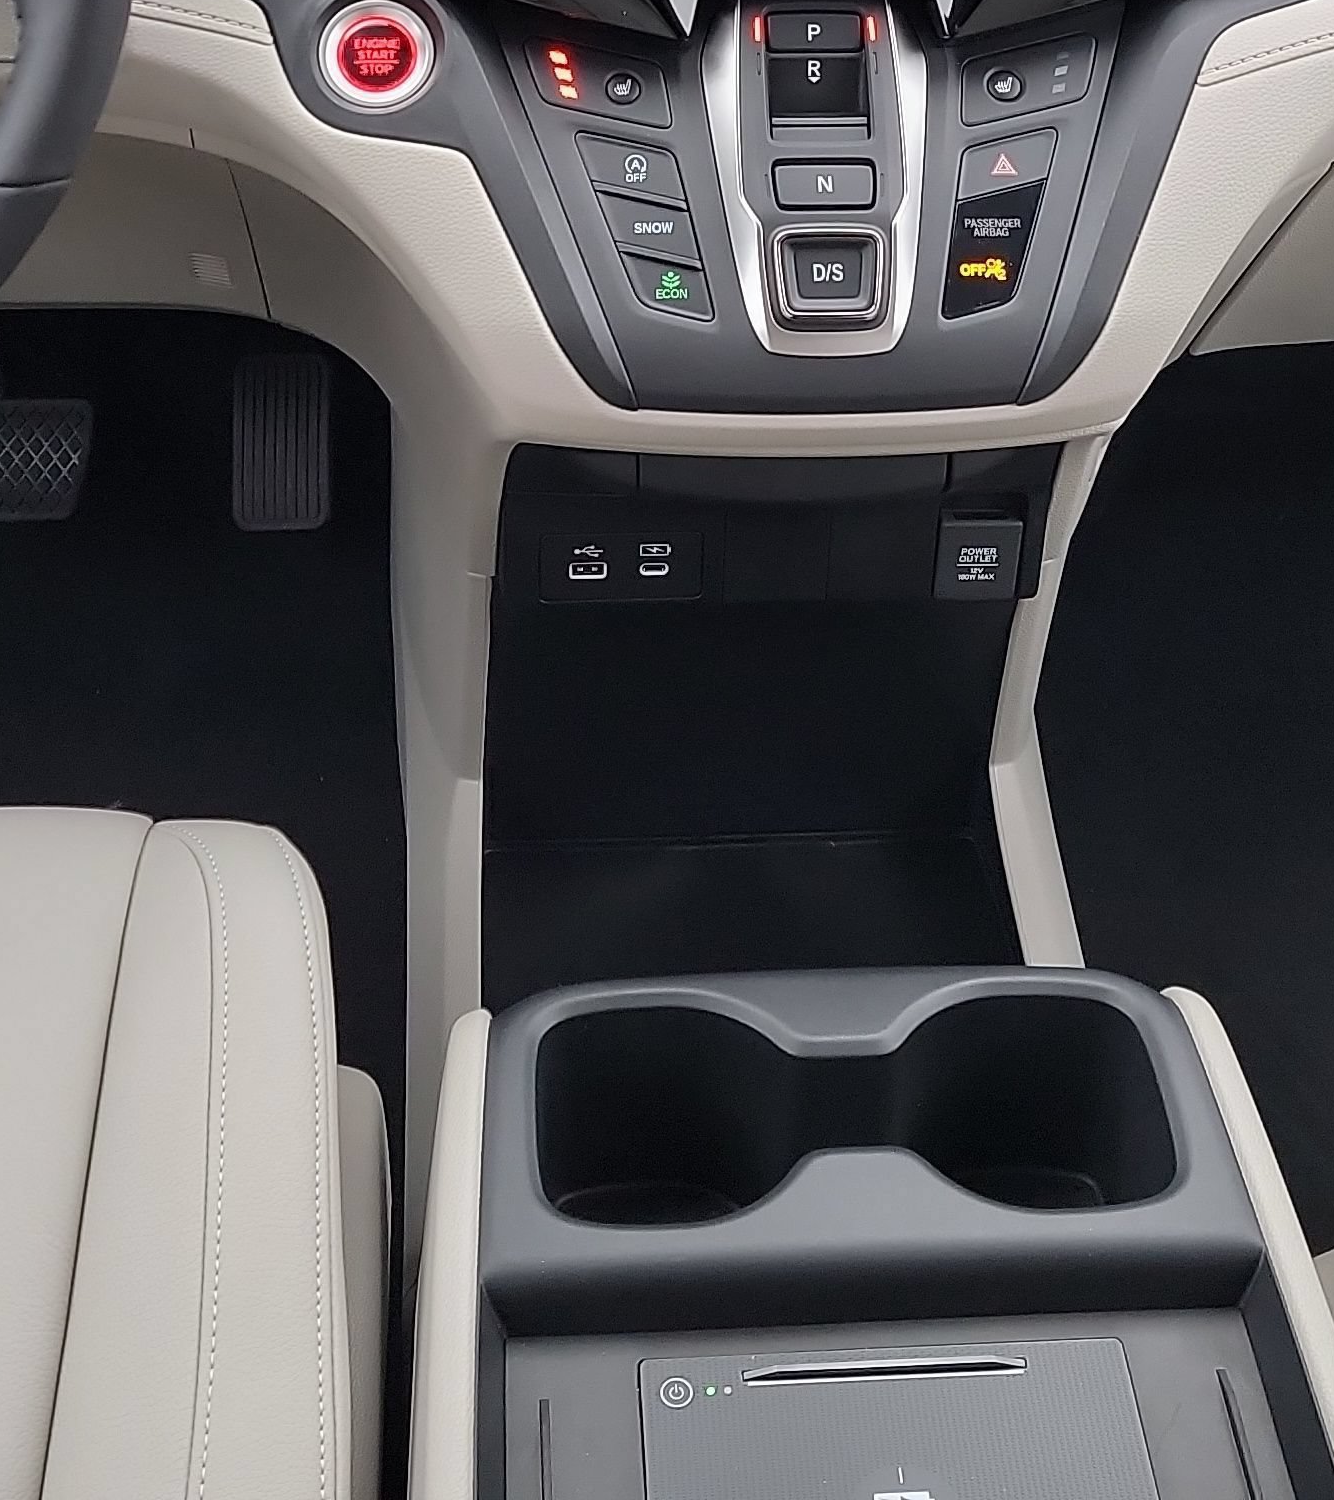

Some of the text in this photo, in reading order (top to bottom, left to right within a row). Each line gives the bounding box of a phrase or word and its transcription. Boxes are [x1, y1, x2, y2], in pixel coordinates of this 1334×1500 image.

[807, 24, 821, 42] P
[353, 38, 400, 49] ENGINE
[356, 50, 397, 60] START
[359, 65, 394, 76] STOP
[807, 60, 821, 78] R
[625, 172, 647, 183] OFF
[817, 175, 833, 194] N
[633, 222, 674, 235] SNOW
[964, 218, 1021, 228] PASSENGER
[974, 228, 1009, 237] AIRBAG
[812, 263, 845, 283] D/S
[960, 264, 986, 276] OFF
[655, 288, 688, 300] ECON
[960, 547, 997, 556] POWER
[958, 555, 998, 563] OUTLET
